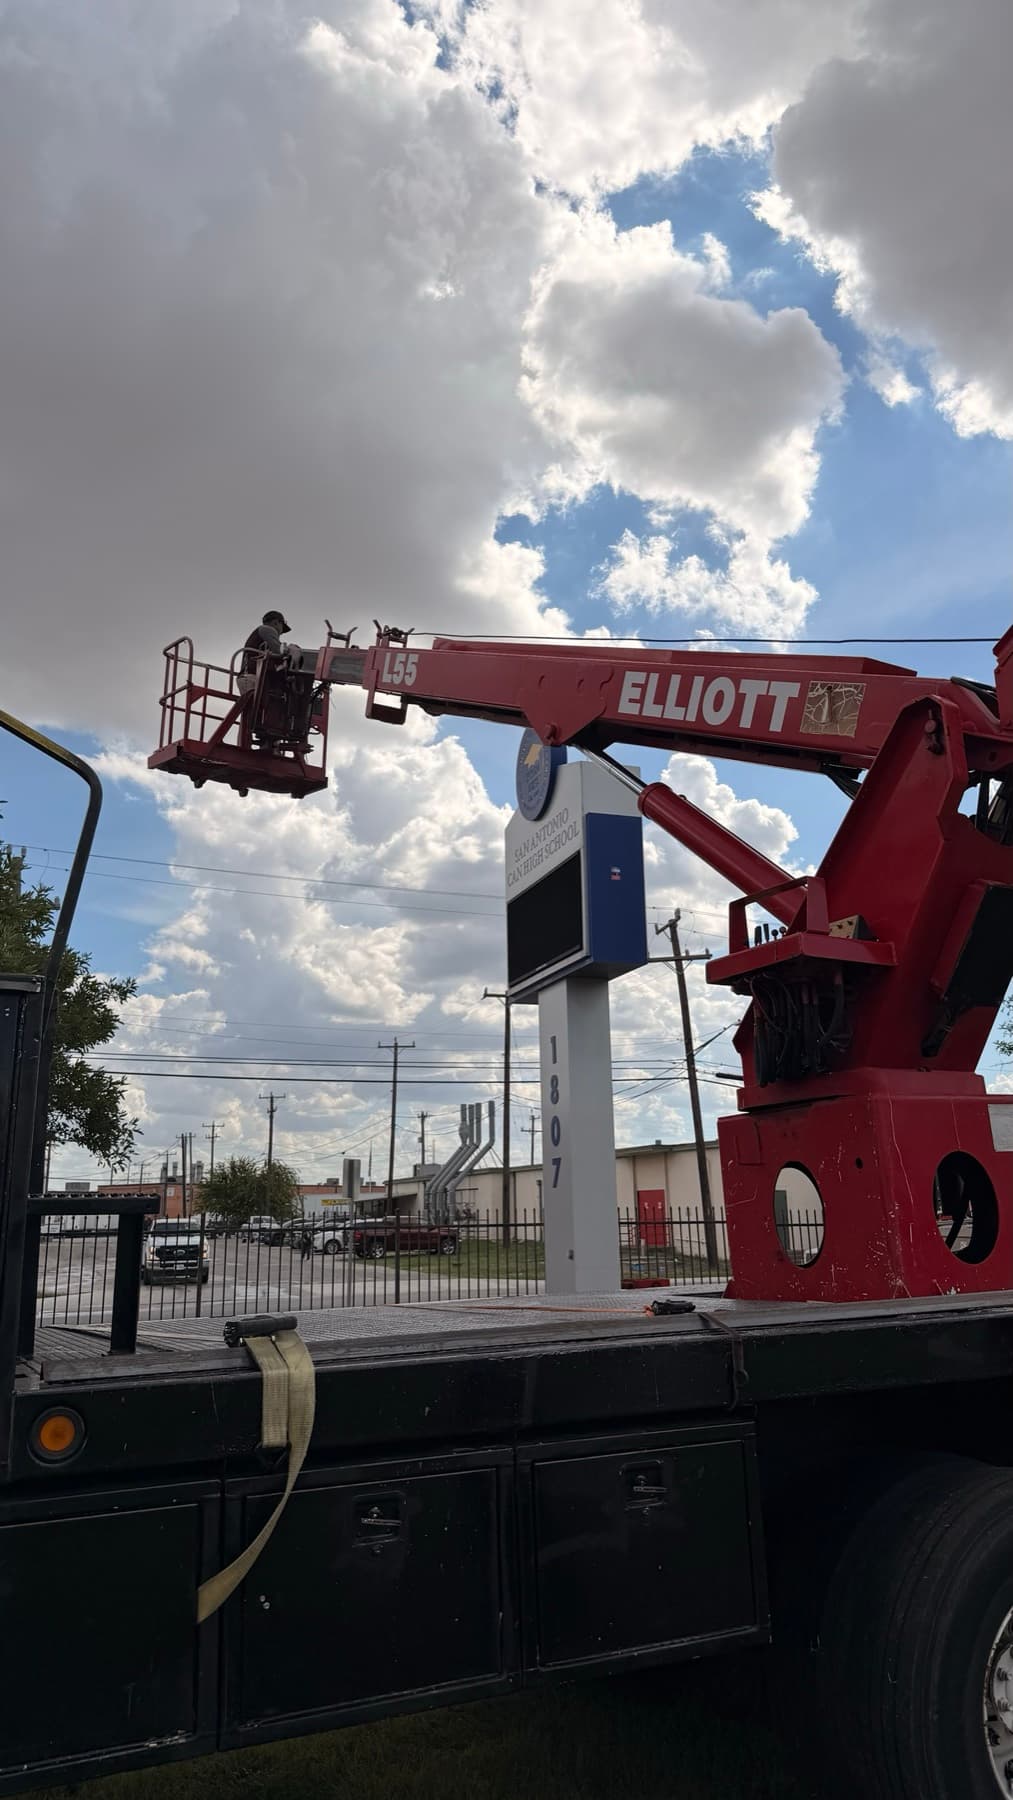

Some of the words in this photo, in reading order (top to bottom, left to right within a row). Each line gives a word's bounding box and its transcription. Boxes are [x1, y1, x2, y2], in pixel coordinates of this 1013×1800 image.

[382, 652, 419, 687] L55
[618, 670, 801, 733] ELLIOTT
[507, 865, 523, 887] CAN
[523, 848, 544, 876] HIGH
[544, 821, 580, 859] SCHOOL
[514, 839, 530, 863] SAN
[530, 807, 569, 851] ANTONIO
[550, 1035, 562, 1189] 1807
